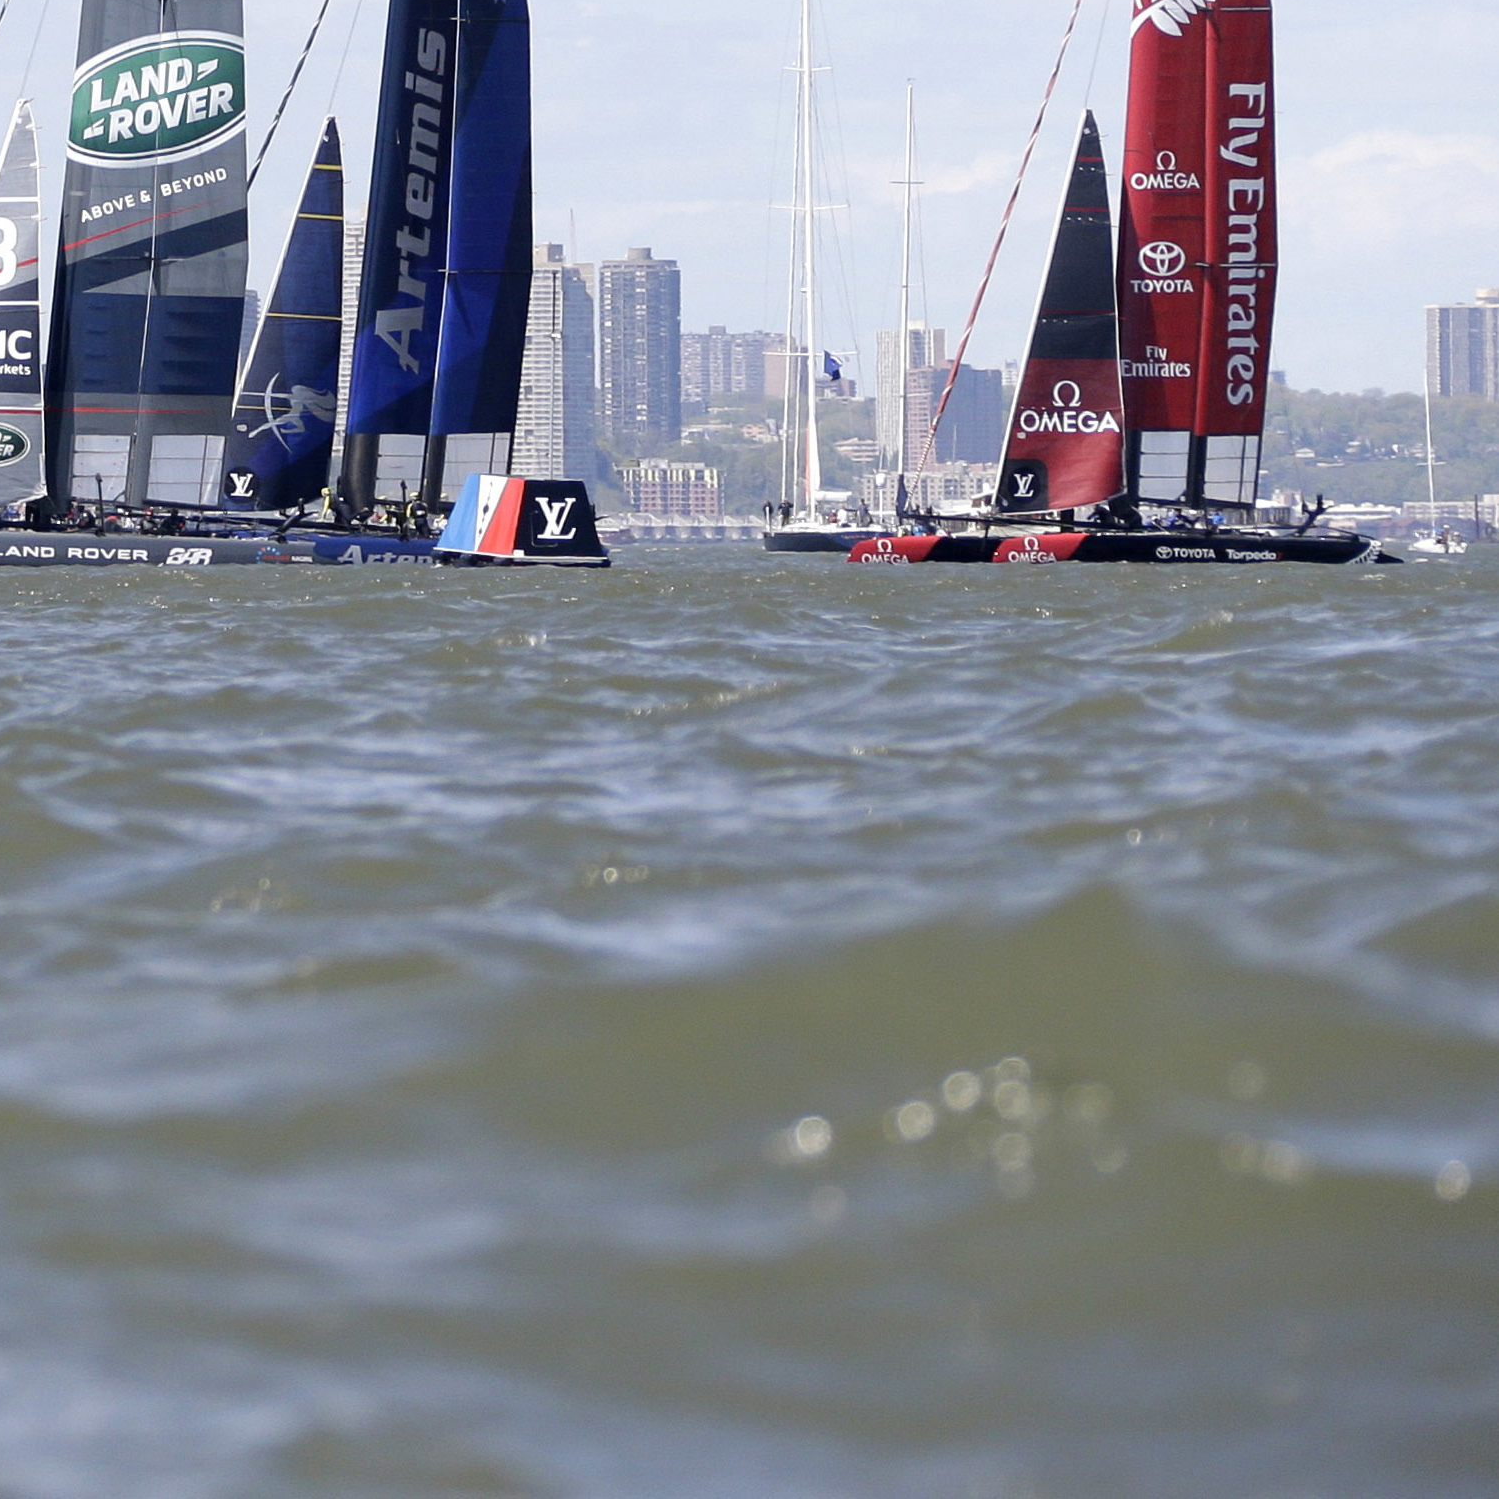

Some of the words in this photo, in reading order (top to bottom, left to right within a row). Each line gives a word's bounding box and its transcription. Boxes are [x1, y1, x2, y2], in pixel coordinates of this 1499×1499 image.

[90, 57, 193, 113] LAND
[108, 82, 234, 144] ROVER
[1220, 81, 1266, 168] Fly
[1130, 172, 1201, 190] OMEGA
[81, 194, 136, 223] ABOVE
[139, 190, 152, 204] &
[160, 167, 228, 197] BEYOND
[375, 27, 447, 375] Artemis
[1130, 279, 1194, 294] TOYOTA
[1226, 176, 1266, 406] Emirates
[1146, 345, 1168, 361] Fly
[1121, 359, 1191, 377] Emirates
[1020, 410, 1120, 433] OMEGA
[67, 547, 149, 561] ROVER
[861, 553, 909, 564] OMEGA
[1007, 551, 1058, 563] OMEGA
[1172, 547, 1216, 559] TOYOTA
